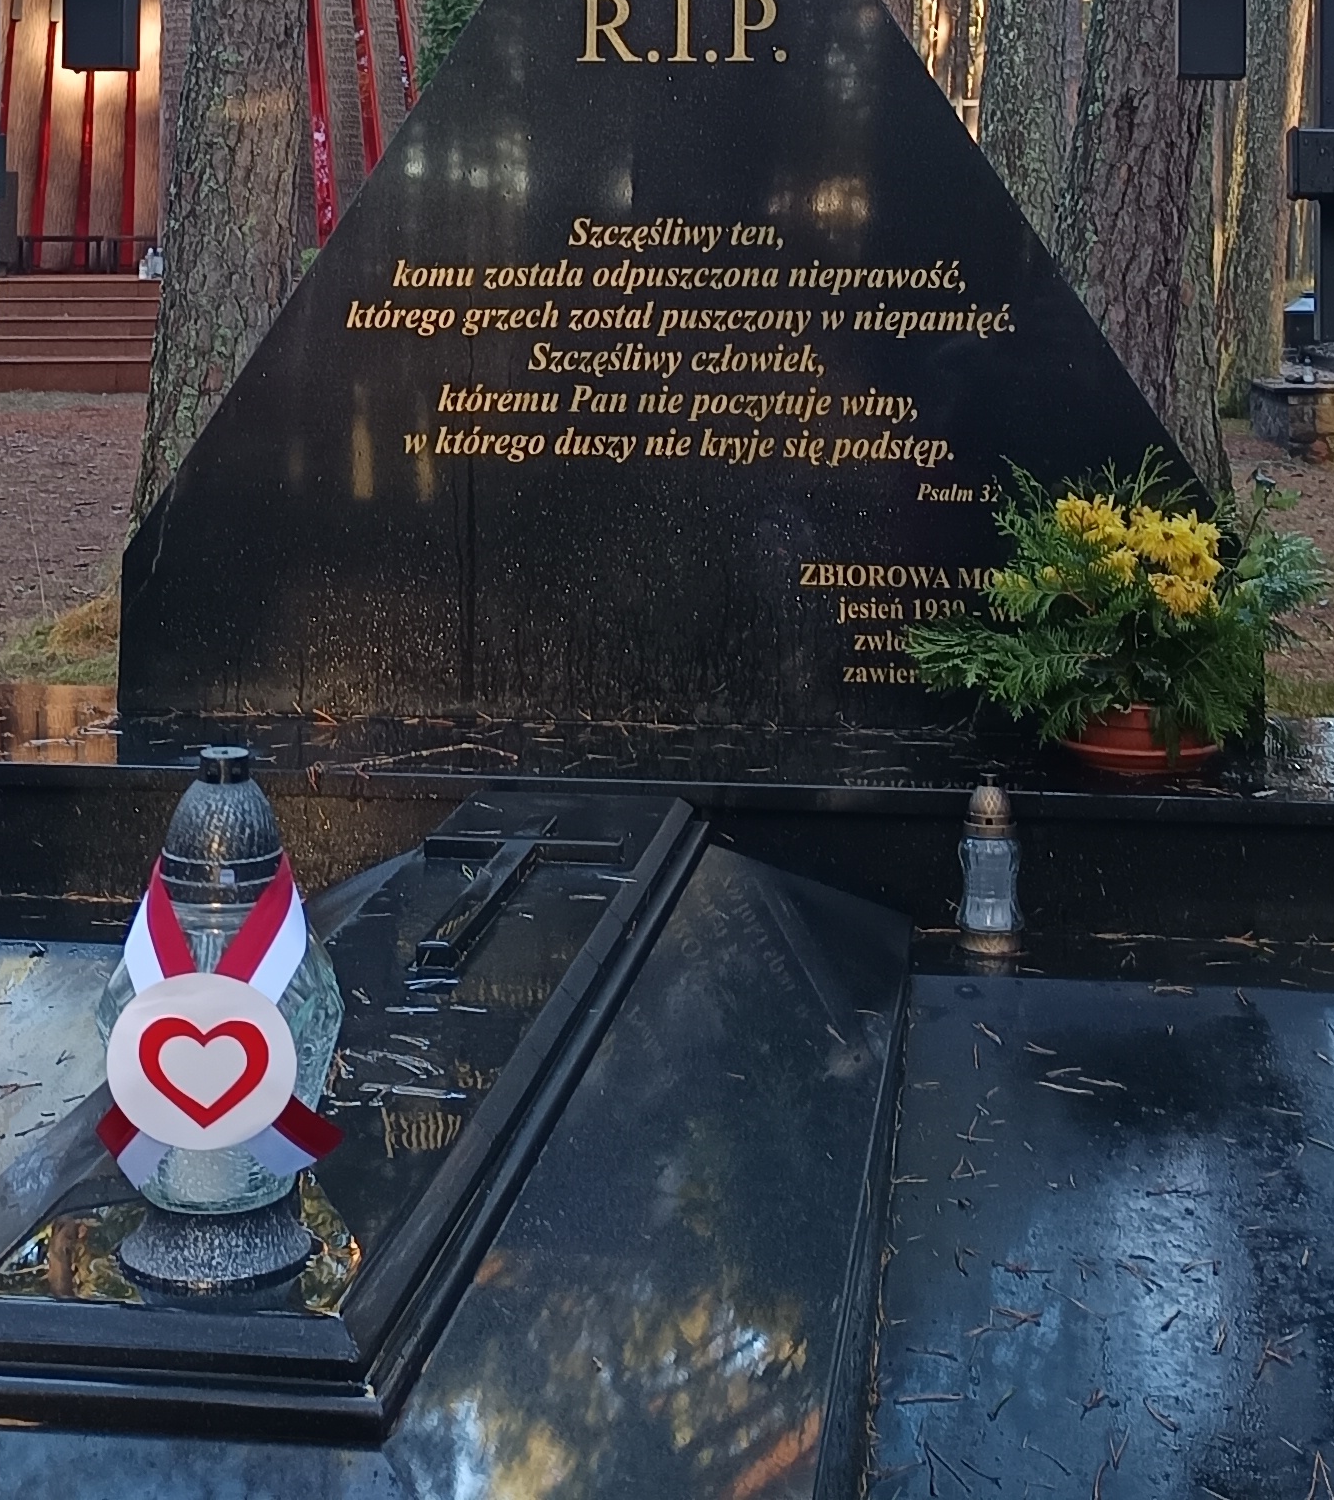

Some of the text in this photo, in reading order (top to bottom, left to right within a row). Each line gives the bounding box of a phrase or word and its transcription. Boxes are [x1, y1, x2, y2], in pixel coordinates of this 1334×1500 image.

[568, 217, 784, 252] Szczęśliwy ten,
[392, 259, 966, 296] komu została odpuszczona nieprawość,
[346, 300, 1016, 339] którego grzech został puszczony w niepamięć.
[528, 342, 825, 378] Szczęśliwy człowiek,
[438, 383, 918, 423] któremu Pan nie poczytuje winy,
[404, 426, 954, 467] w którego duszy nie kryje się podstęp.
[917, 483, 973, 502] Psalm
[800, 563, 950, 590] ZBIOROWA
[837, 596, 903, 625] jesień
